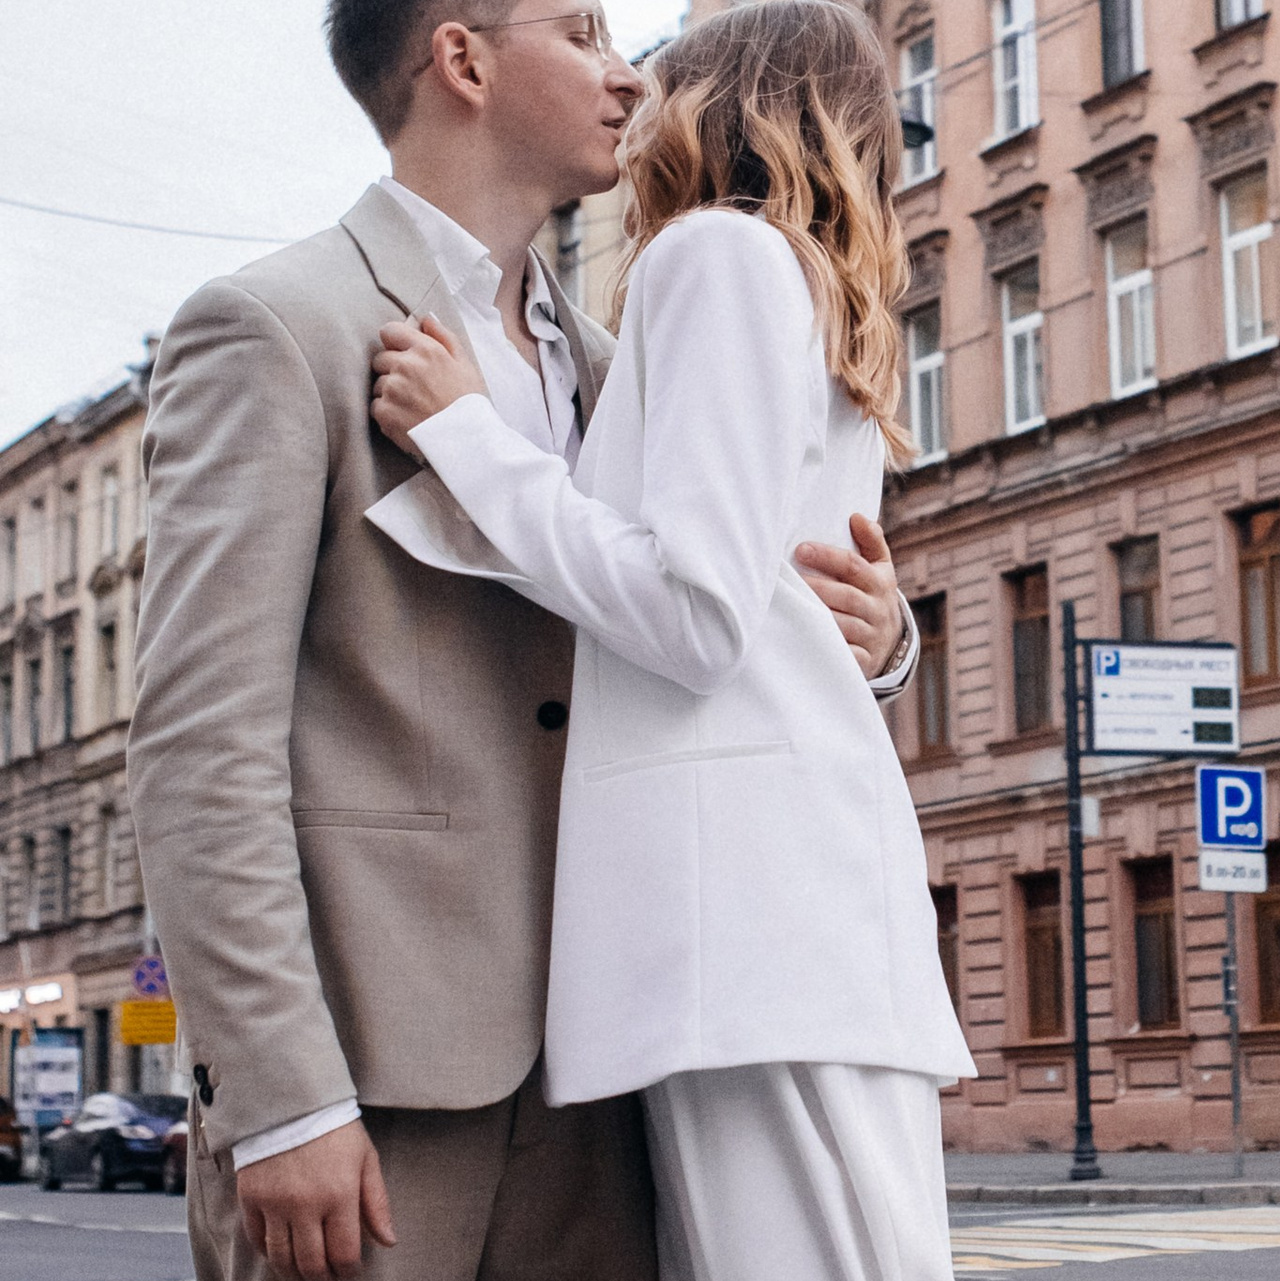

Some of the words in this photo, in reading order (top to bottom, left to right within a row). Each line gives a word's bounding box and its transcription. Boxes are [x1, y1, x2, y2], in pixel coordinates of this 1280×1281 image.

[1099, 650, 1117, 676] P
[1200, 660, 1231, 672] МЕСТ
[1217, 776, 1253, 838] P
